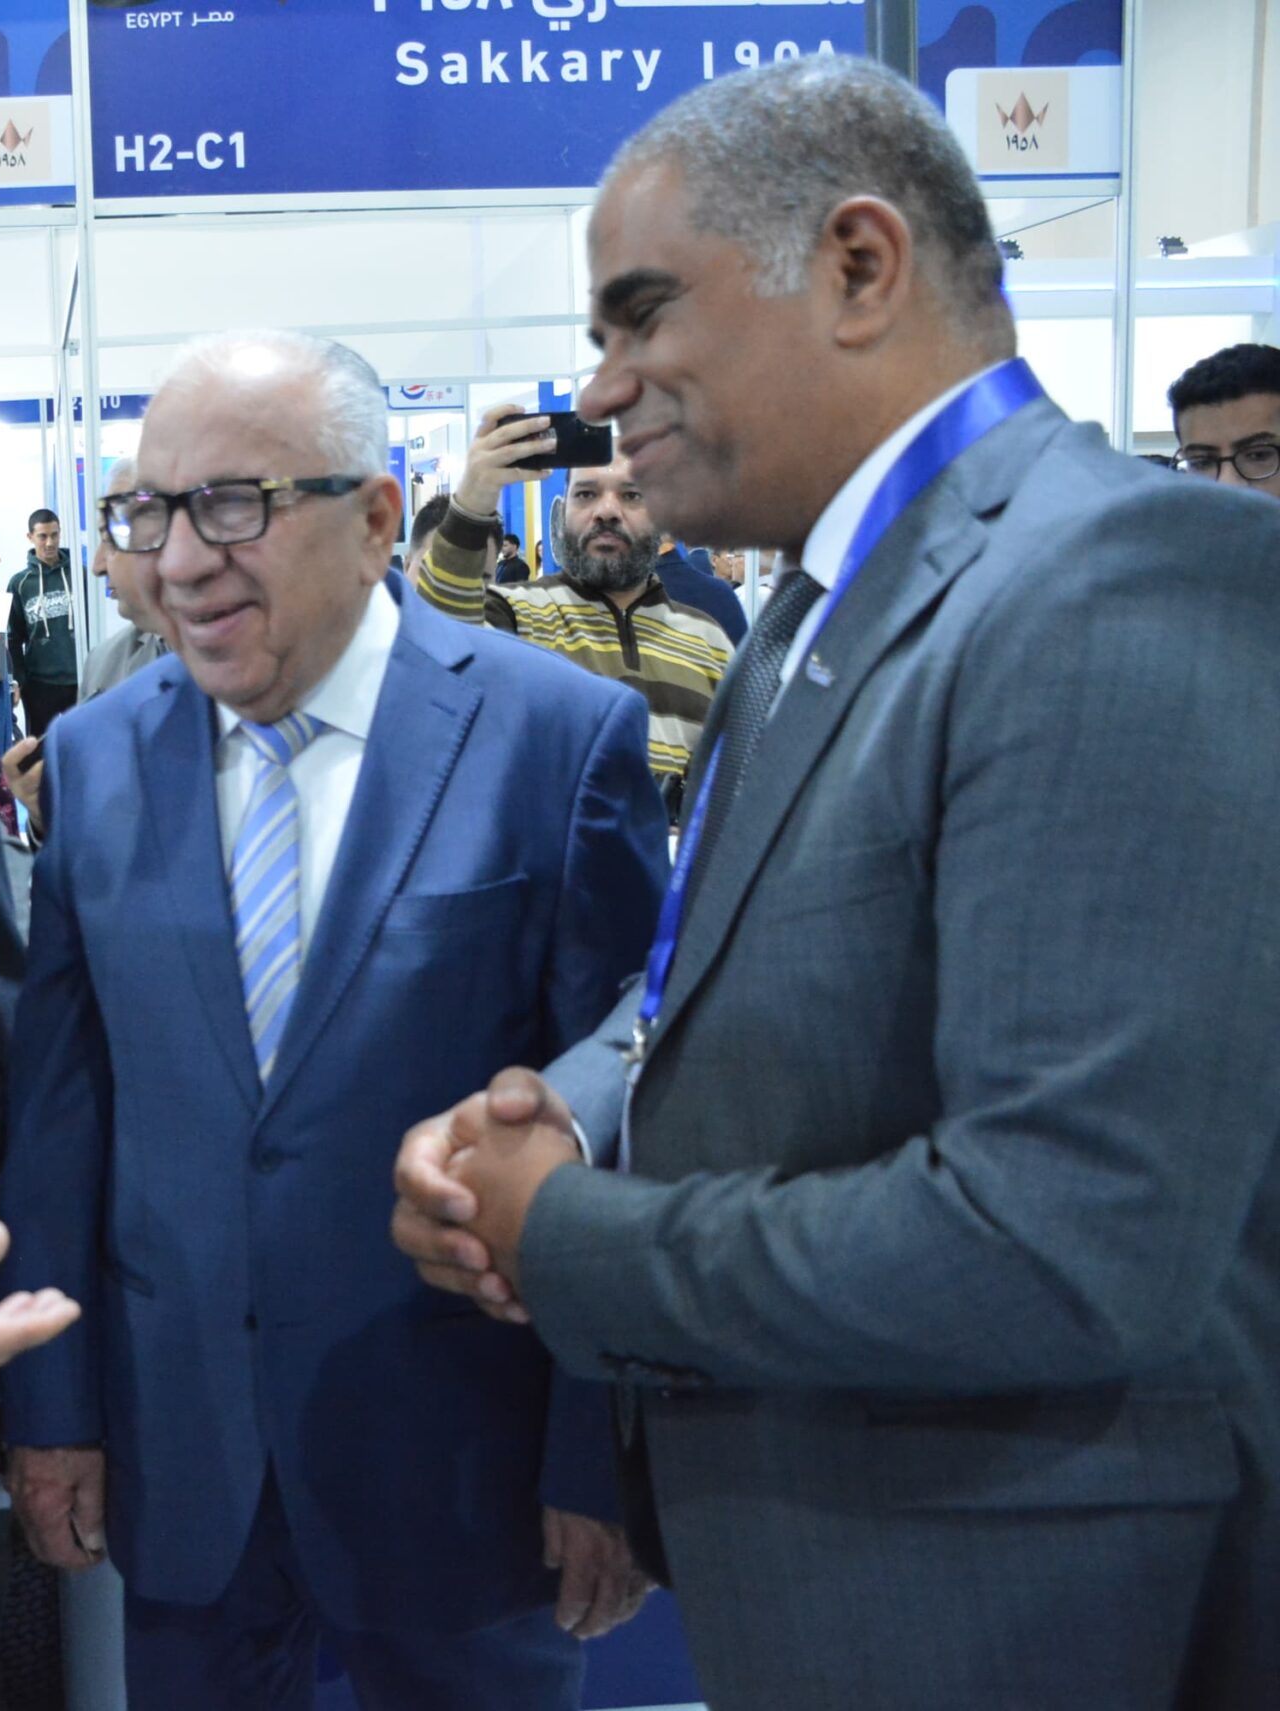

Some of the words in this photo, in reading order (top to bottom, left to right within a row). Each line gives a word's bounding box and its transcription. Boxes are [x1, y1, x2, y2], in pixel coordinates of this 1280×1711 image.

[125, 12, 183, 29] EGYPT
[191, 11, 235, 27] مصر
[395, 39, 662, 91] Sakkary
[115, 131, 246, 172] H2-C1
